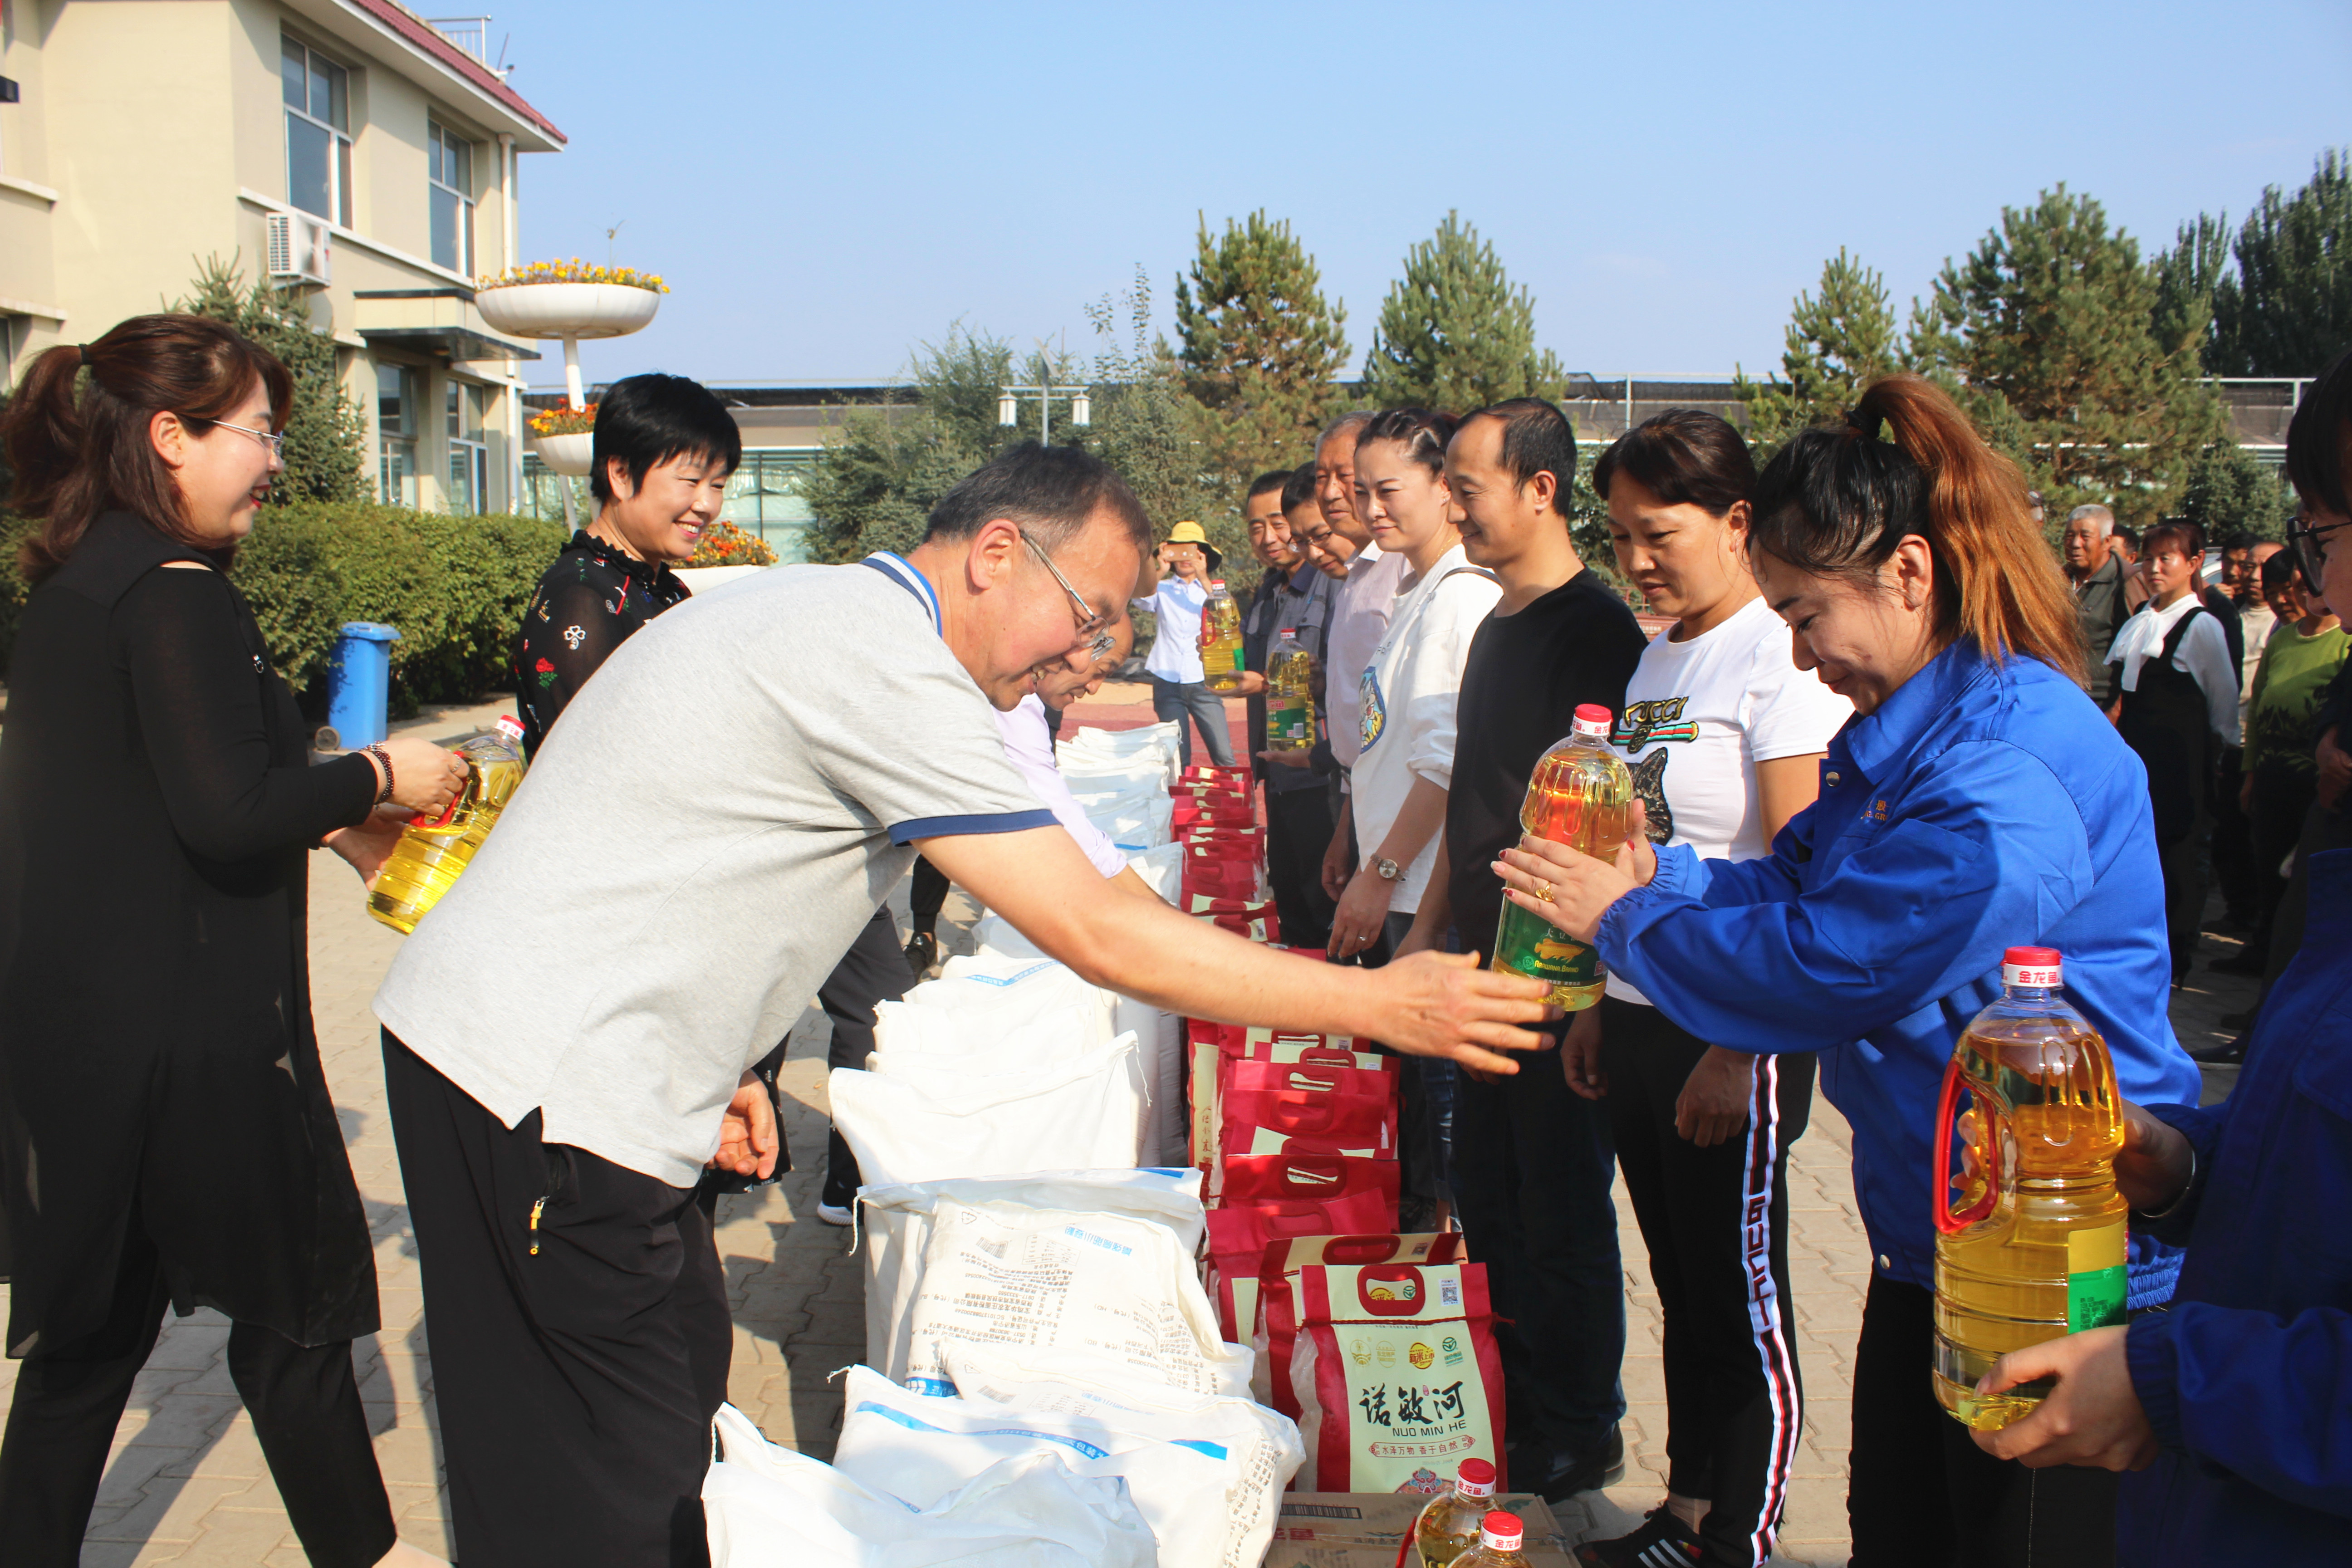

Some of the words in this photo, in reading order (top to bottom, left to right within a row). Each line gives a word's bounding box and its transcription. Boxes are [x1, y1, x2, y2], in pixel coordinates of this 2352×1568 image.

[1534, 960, 1560, 971] ARAWANA
[2019, 970, 2057, 984] 金龙鱼
[1747, 1196, 1772, 1327] GUCCI
[1358, 1381, 1465, 1426] 诺敏河
[1392, 1428, 1416, 1436] NUO
[1421, 1426, 1444, 1436] MIN
[1449, 1419, 1467, 1432] HE
[1382, 1445, 1415, 1455] 水泽万物
[1419, 1441, 1458, 1455] 香于自然
[1457, 1480, 1482, 1495] 金龙鱼
